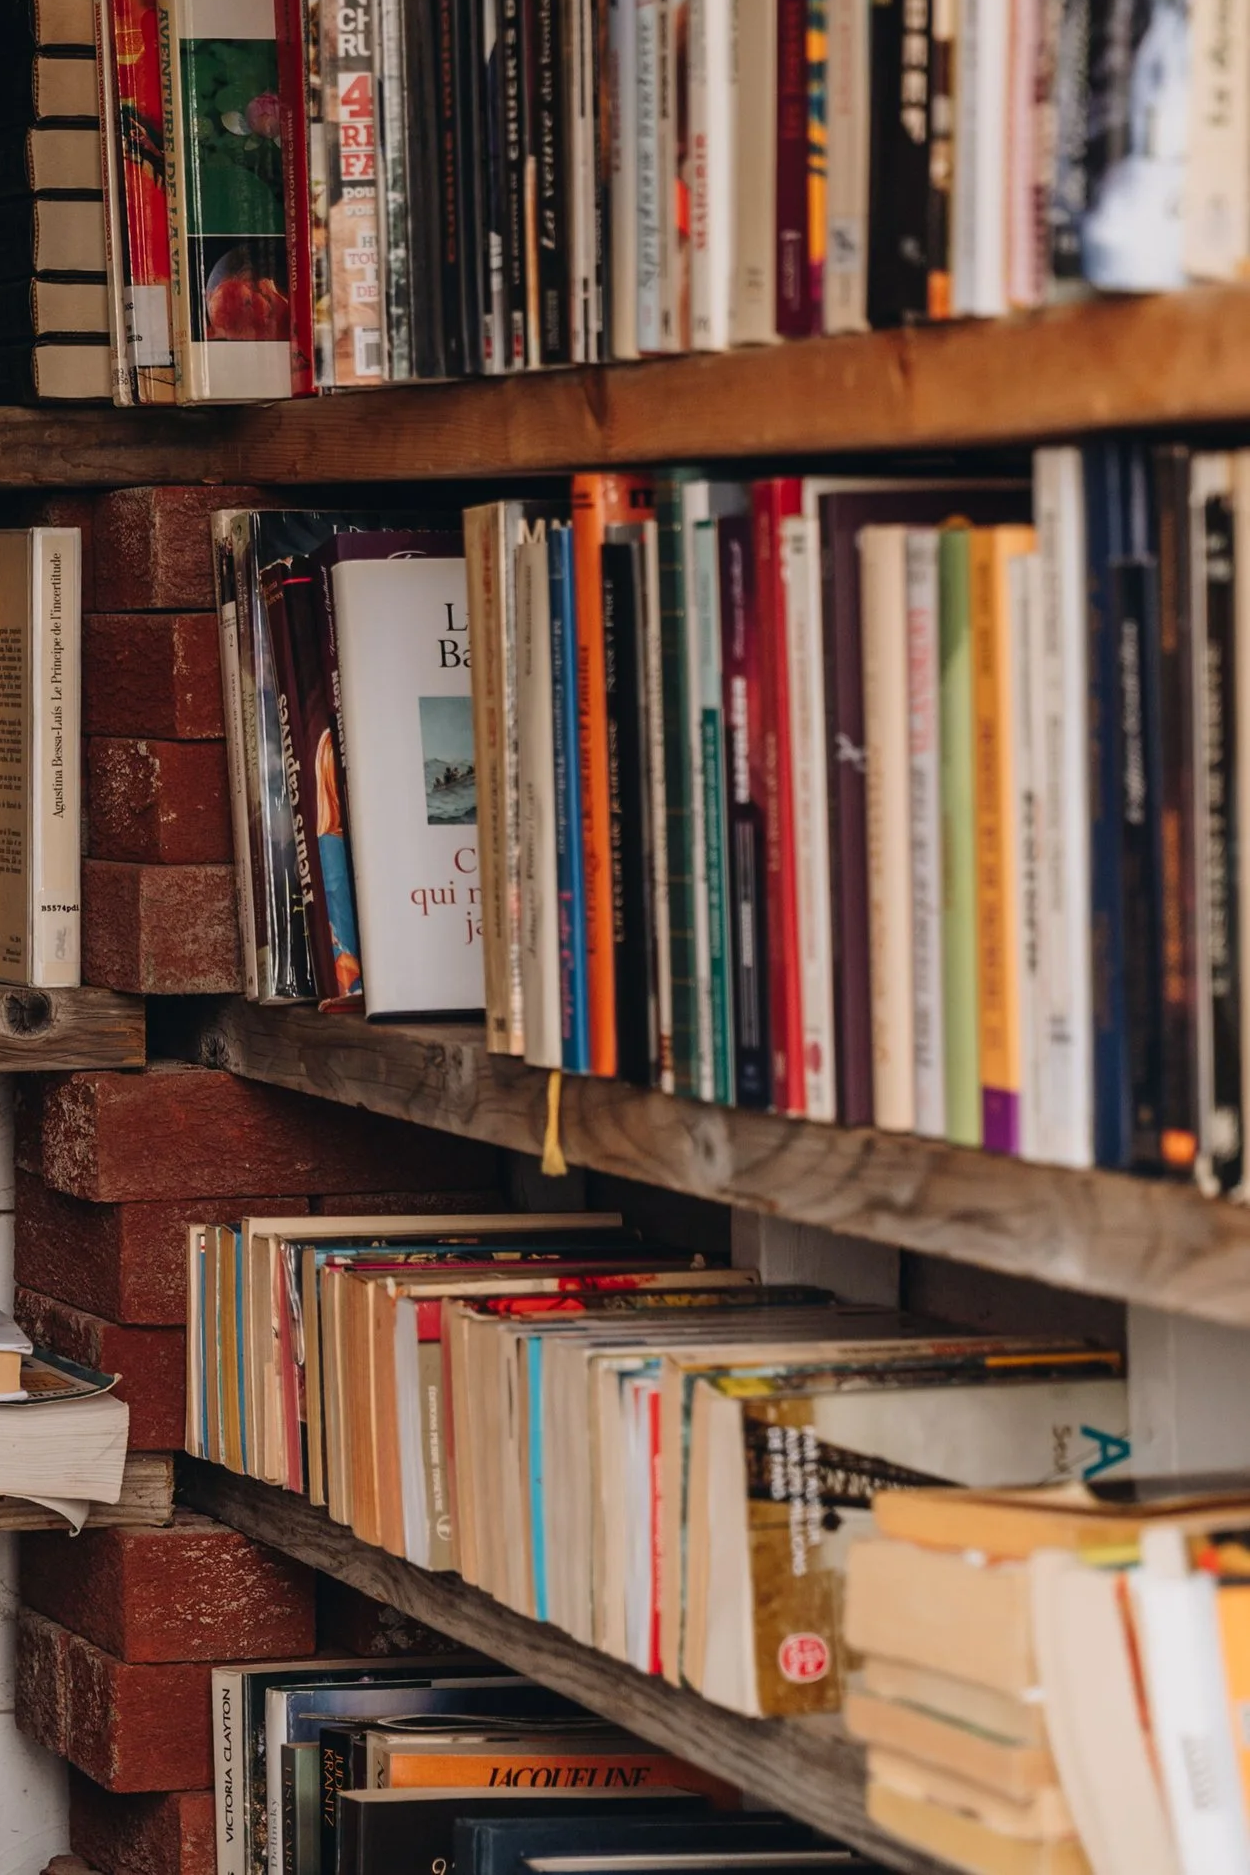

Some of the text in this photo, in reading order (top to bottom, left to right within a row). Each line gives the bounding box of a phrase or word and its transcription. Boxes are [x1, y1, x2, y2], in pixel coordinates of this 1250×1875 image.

[157, 5, 176, 155] AVENTURE
[164, 163, 178, 200] DE
[167, 205, 180, 242] LA
[170, 249, 183, 297] VIE
[446, 603, 468, 632] L
[278, 693, 302, 808] captives
[410, 881, 457, 916] qui
[1079, 1424, 1132, 1480] A
[223, 1688, 235, 1843] VICTORIA CLAYTON
[324, 1748, 335, 1827] KRANTZ
[270, 1798, 280, 1868] Delinsky
